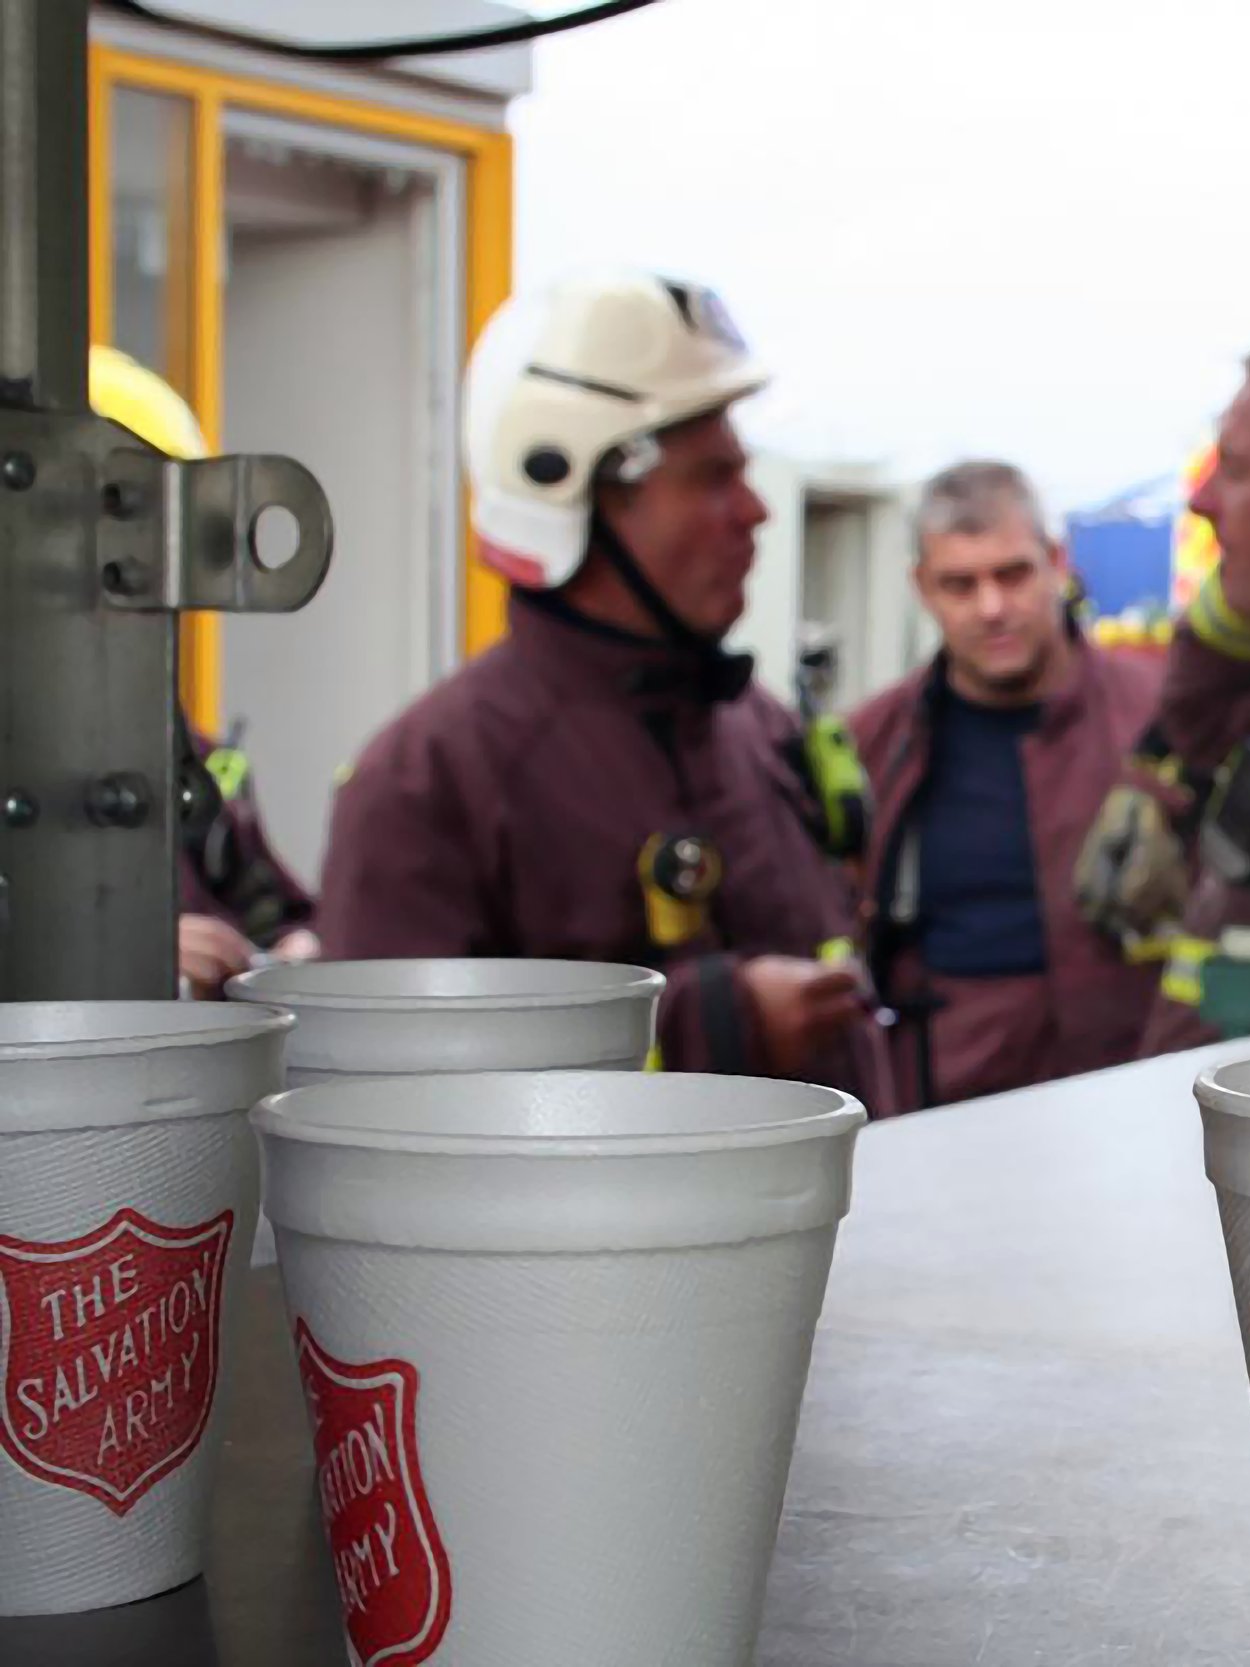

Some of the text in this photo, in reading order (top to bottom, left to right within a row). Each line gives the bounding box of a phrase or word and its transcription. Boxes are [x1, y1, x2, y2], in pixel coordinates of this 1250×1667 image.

[16, 1251, 209, 1440] SALVATION
[41, 1253, 139, 1341] THE
[97, 1332, 199, 1465] ARMY
